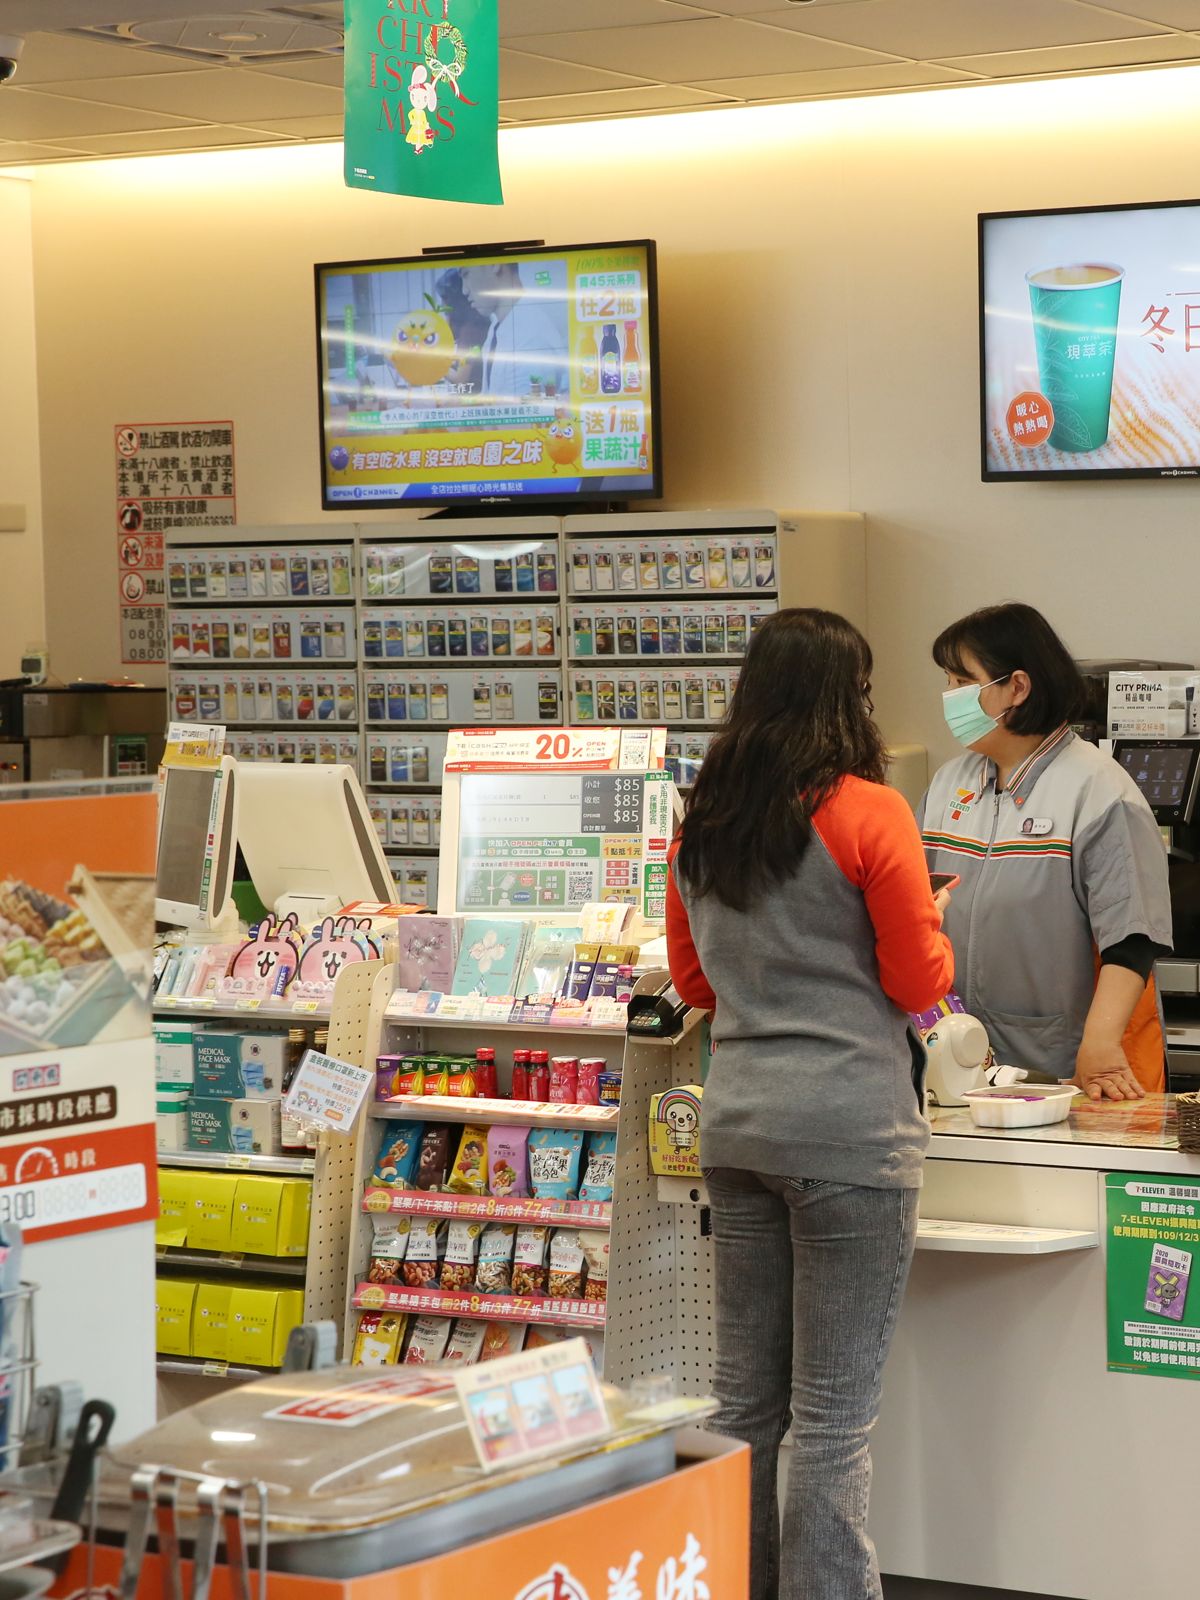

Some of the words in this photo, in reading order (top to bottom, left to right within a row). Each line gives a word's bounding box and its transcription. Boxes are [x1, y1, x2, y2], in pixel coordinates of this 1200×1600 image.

[1066, 340, 1112, 360] 現萃茶
[1016, 401, 1039, 417] 暖心
[585, 403, 640, 434] 送1瓶
[1013, 416, 1048, 437] 熱熱喝
[139, 431, 179, 449] 禁止酒駕
[181, 429, 231, 447] 飲酒勿開車
[352, 449, 421, 471] 有空吃水果
[425, 440, 543, 468] 沒空就喝園之味
[585, 436, 640, 462] 果蔬汁
[118, 471, 233, 484] 本場所不販賣酒予
[118, 483, 233, 497] 未滿十八歲者
[142, 501, 207, 514] 吸菸有害健康
[129, 629, 164, 640] 0800
[130, 649, 164, 659] 0800
[1116, 684, 1134, 692] CITY
[1136, 684, 1163, 692] PRIMA
[1126, 693, 1152, 702] 精品咖啡
[585, 780, 600, 789] 小計
[614, 778, 640, 792] $85
[614, 793, 639, 807] $85
[613, 809, 639, 823] $85
[604, 846, 642, 856] 1點抵1元
[198, 1048, 224, 1056] MEDICAL
[198, 1055, 213, 1063] FACE
[214, 1056, 231, 1064] MASK
[191, 1112, 215, 1120] MEDICAL
[191, 1119, 206, 1128] FACE
[206, 1120, 222, 1128] MASK
[1141, 1202, 1195, 1215] 因應政府法令
[1155, 1249, 1169, 1258] 2020
[389, 1292, 441, 1308] 堅果隨手包
